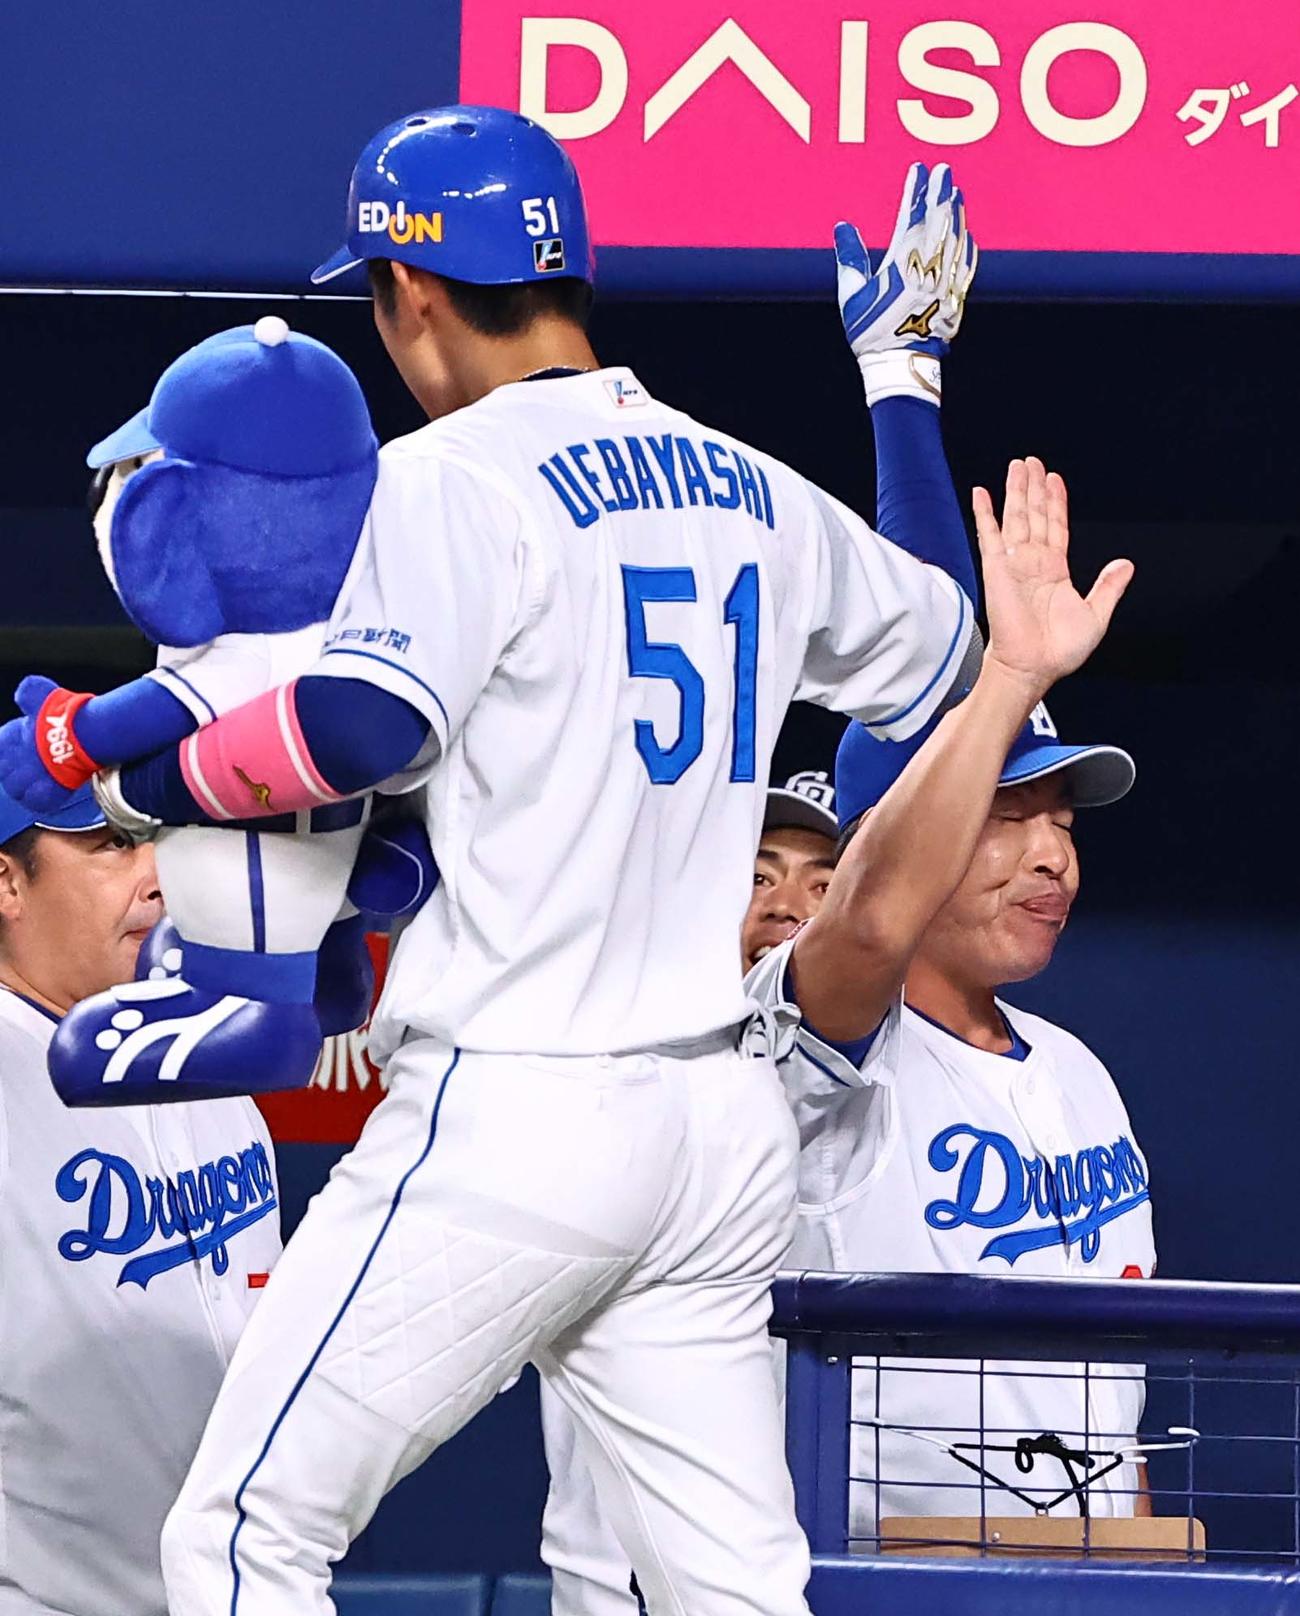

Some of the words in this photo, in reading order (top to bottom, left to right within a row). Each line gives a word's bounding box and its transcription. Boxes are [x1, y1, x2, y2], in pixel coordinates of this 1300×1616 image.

[518, 16, 1148, 146] DAISO
[1175, 81, 1300, 148] ダイ
[358, 201, 442, 243] EDION
[522, 197, 559, 237] 51
[539, 433, 774, 530] UEBAYASHI
[620, 563, 760, 785] 51
[924, 1122, 1150, 1267] Dragons
